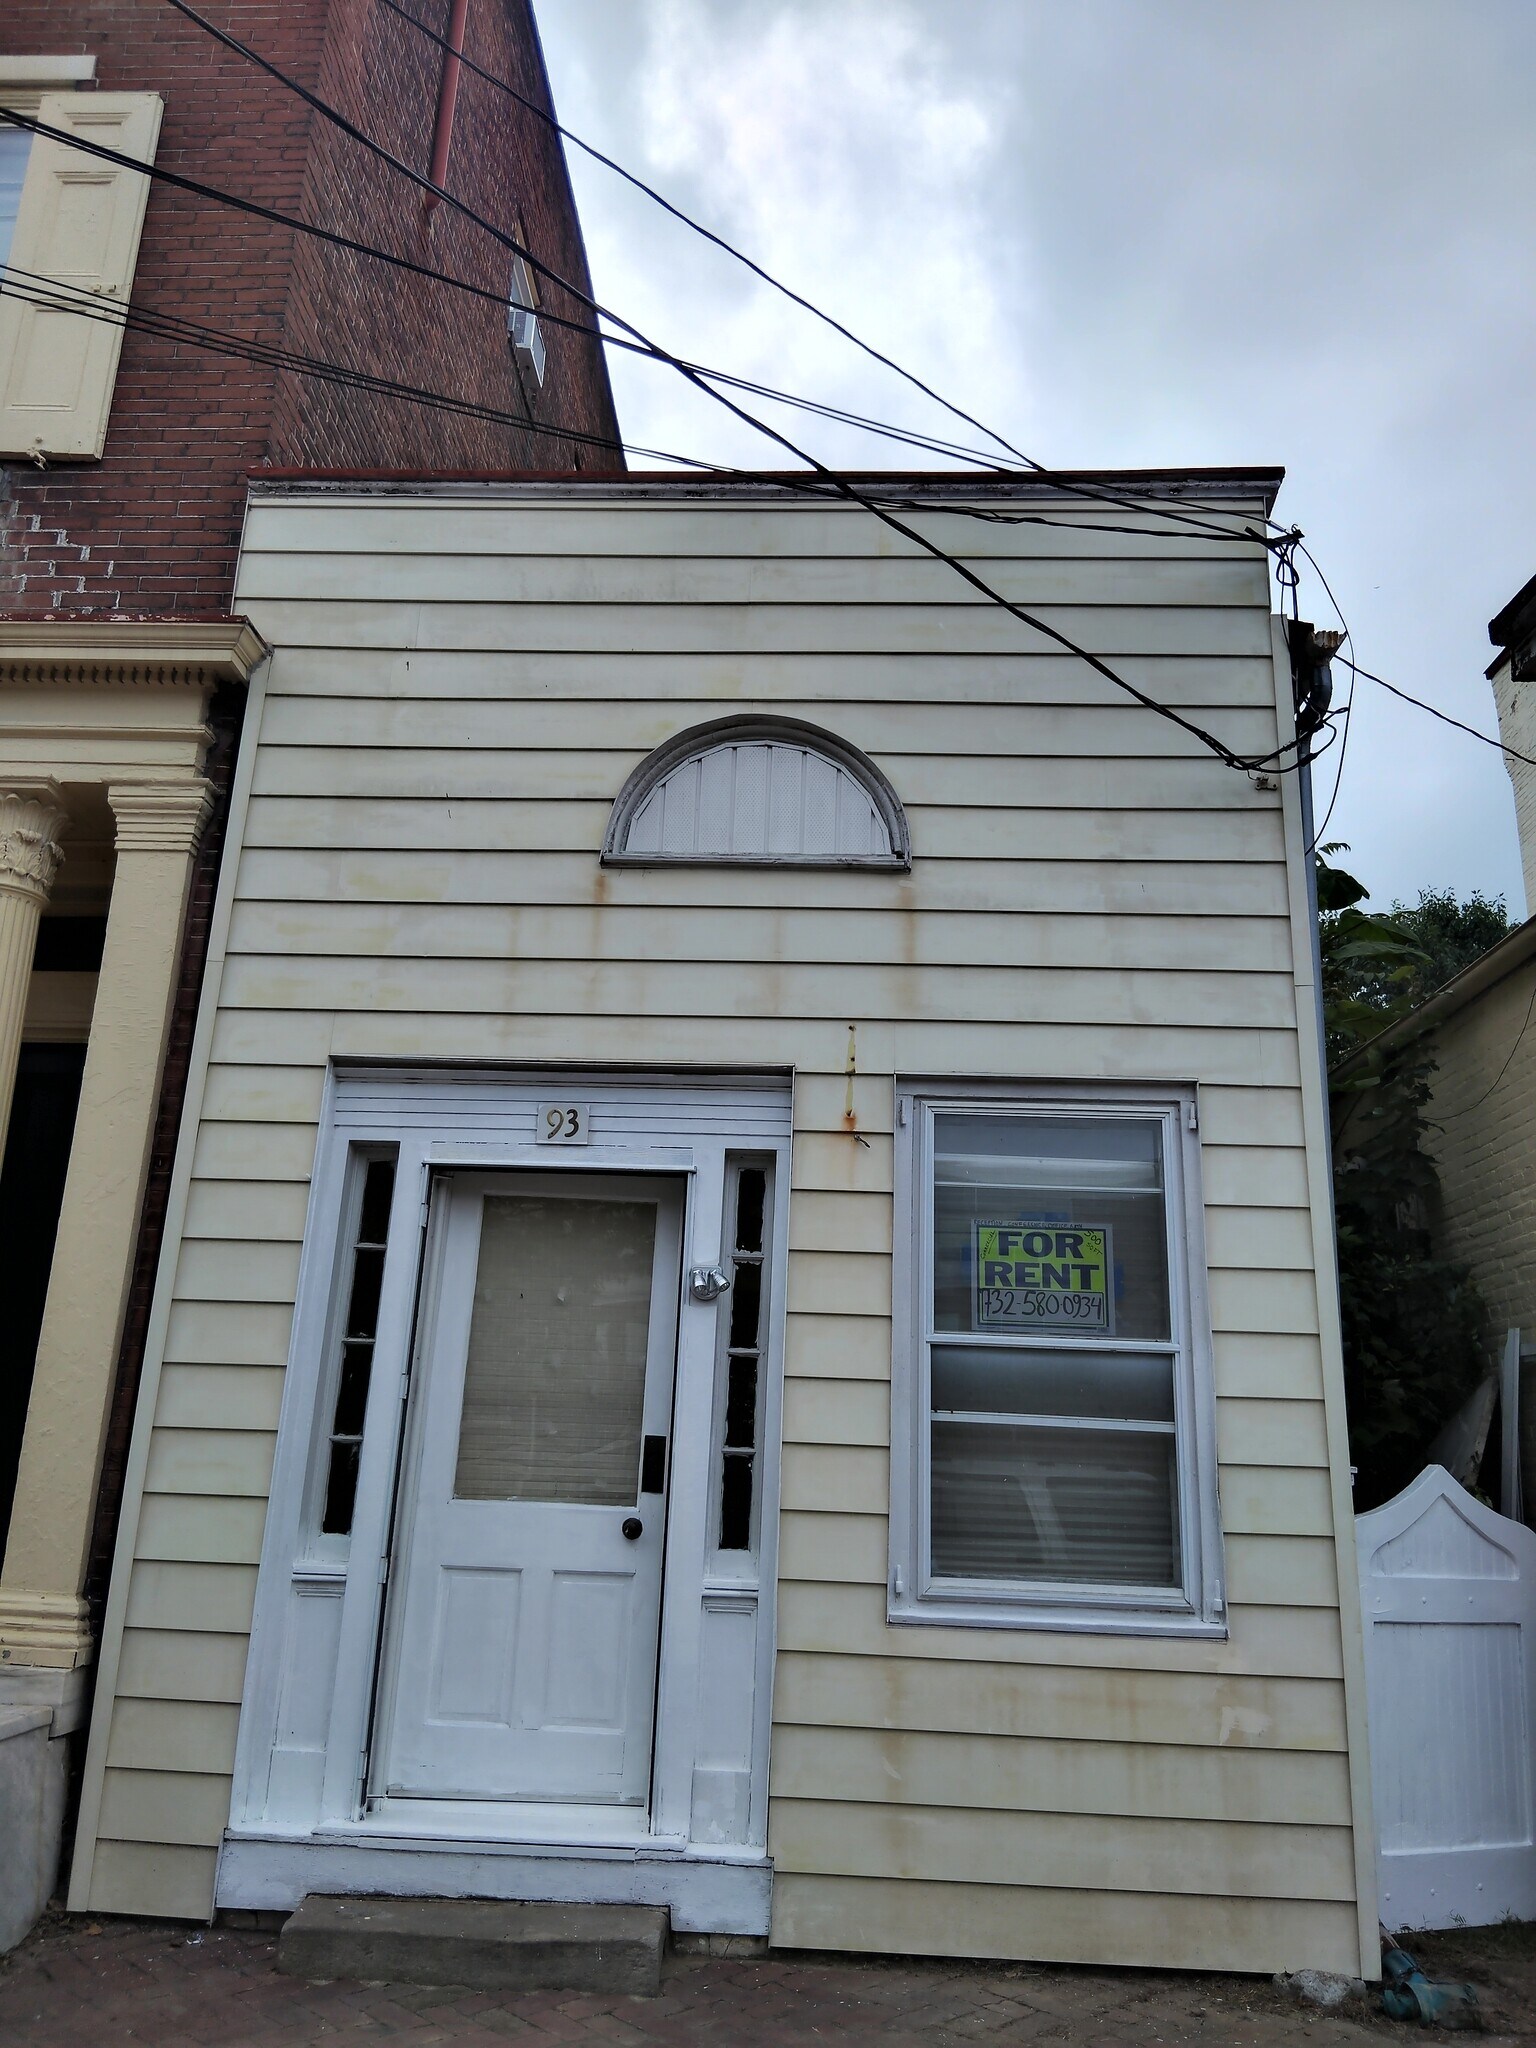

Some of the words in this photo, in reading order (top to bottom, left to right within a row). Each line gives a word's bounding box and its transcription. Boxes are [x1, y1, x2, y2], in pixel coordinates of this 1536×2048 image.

[547, 1108, 579, 1139] 93
[998, 1231, 1084, 1258] FOR
[1084, 1230, 1102, 1245] 500
[985, 1261, 1100, 1290] RENT
